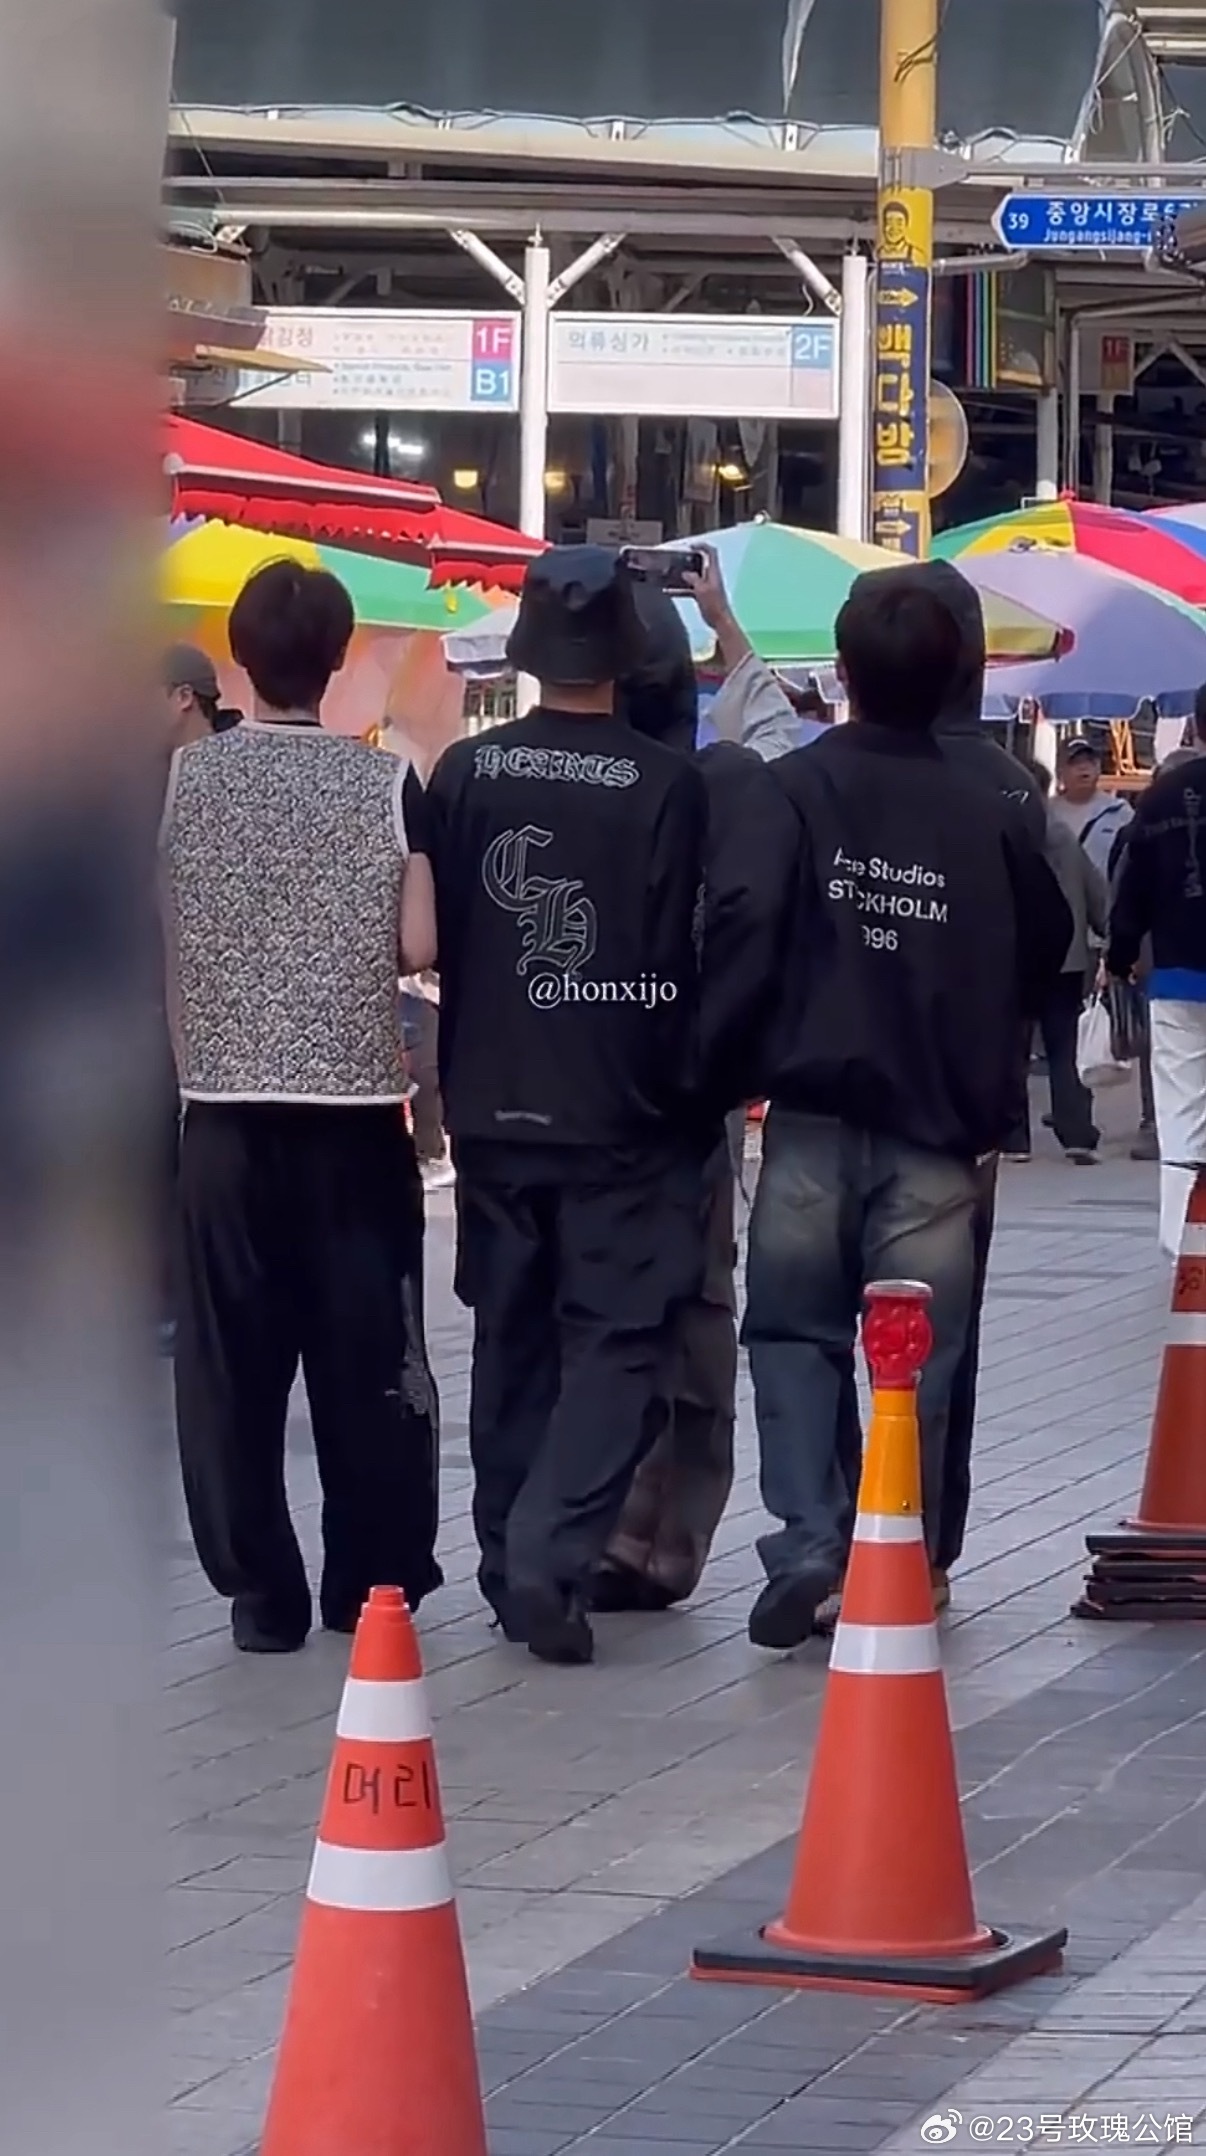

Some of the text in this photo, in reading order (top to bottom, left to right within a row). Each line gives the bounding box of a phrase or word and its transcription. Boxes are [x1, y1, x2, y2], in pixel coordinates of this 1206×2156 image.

[1008, 213, 1029, 230] 39
[477, 330, 511, 353] 1F
[795, 335, 832, 360] 2F
[476, 370, 509, 395] B1
[869, 857, 946, 888] Studios
